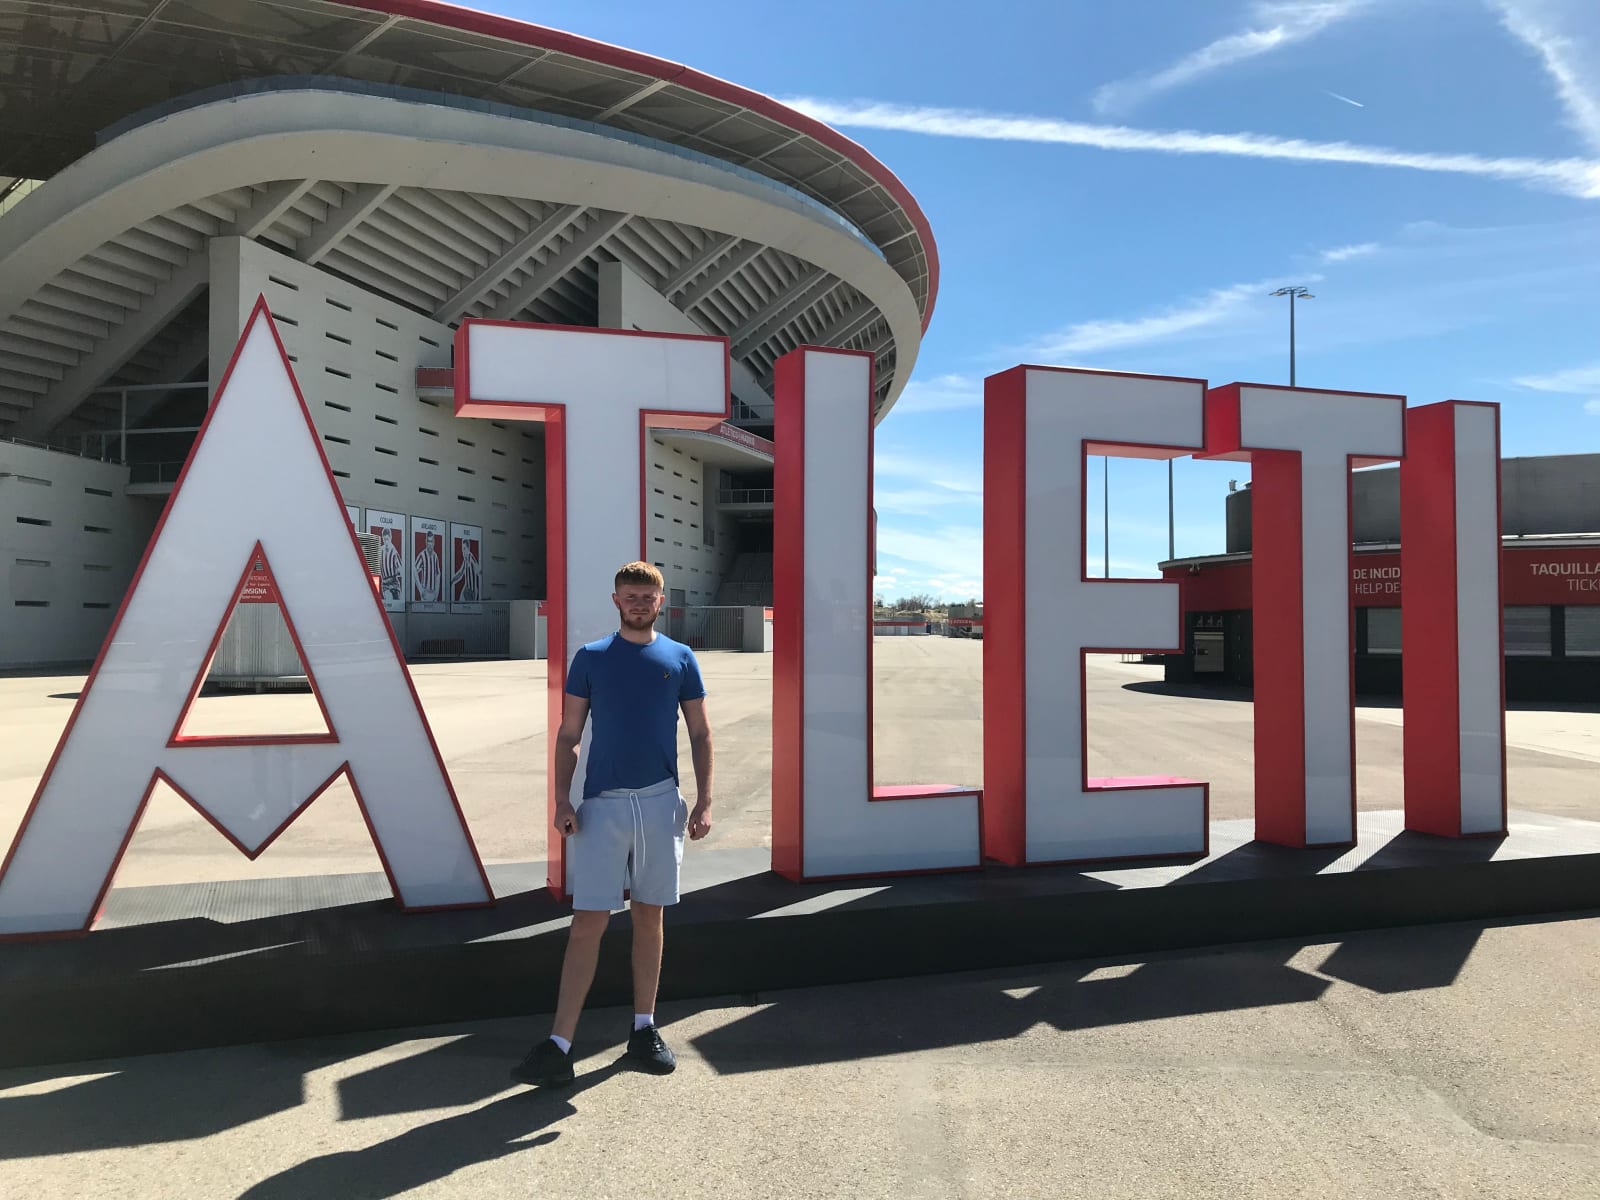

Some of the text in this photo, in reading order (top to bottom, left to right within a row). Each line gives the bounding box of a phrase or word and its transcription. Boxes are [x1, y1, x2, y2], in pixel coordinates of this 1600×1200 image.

[1352, 568, 1368, 580] DE
[1355, 582, 1402, 594] HELP DE
[1566, 578, 1600, 592] TICK
[0, 294, 1506, 935] ATLETI
